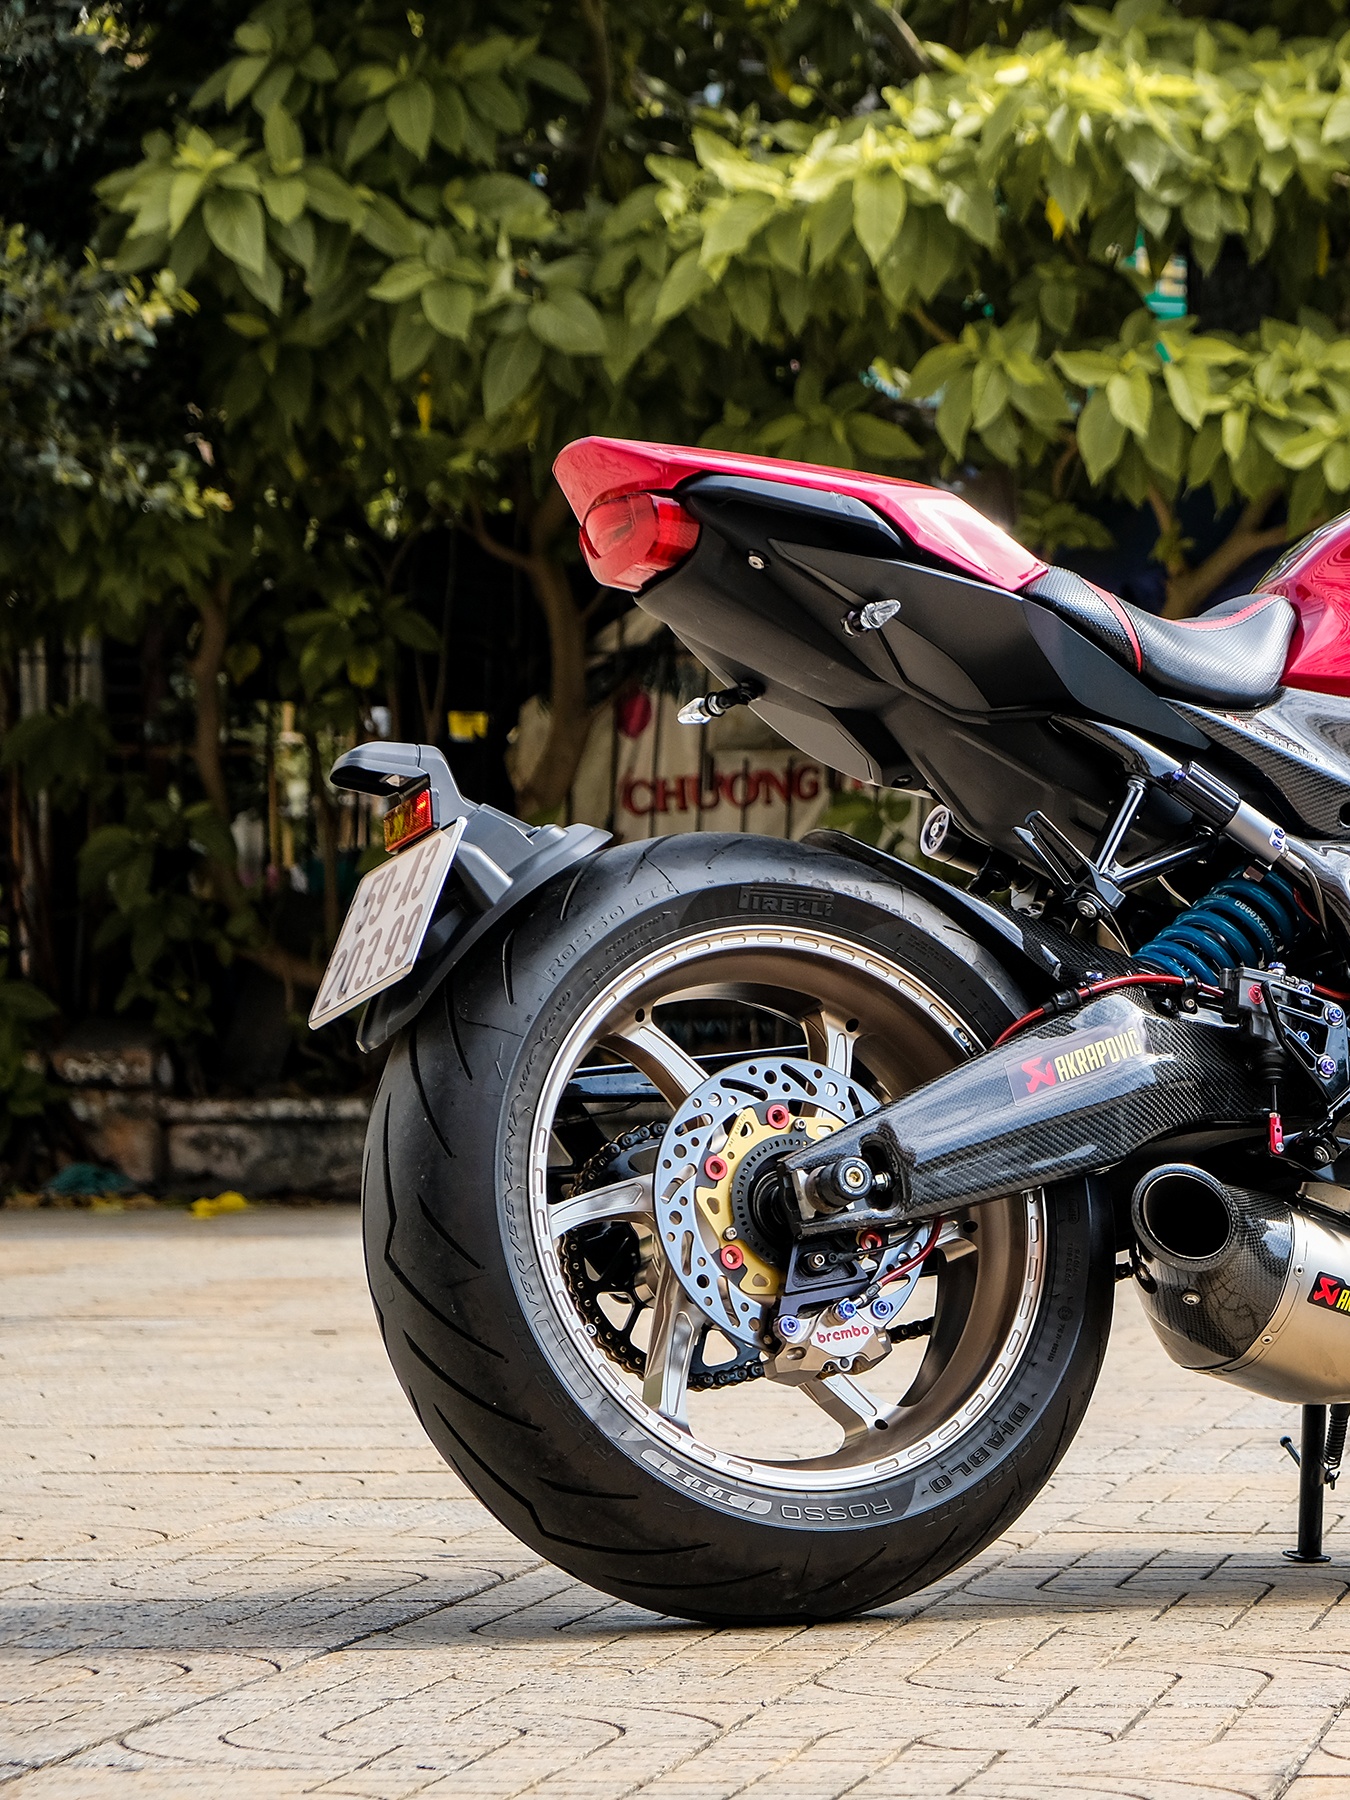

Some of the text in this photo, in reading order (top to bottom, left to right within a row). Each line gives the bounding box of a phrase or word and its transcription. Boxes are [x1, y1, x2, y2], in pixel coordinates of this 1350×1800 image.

[737, 885, 836, 918] PIRELLI
[1054, 1027, 1143, 1082] AKRAPOVIČ
[816, 1325, 870, 1344] brembo
[929, 1401, 1032, 1494] DIABLO
[780, 1498, 894, 1521] ROSSO
